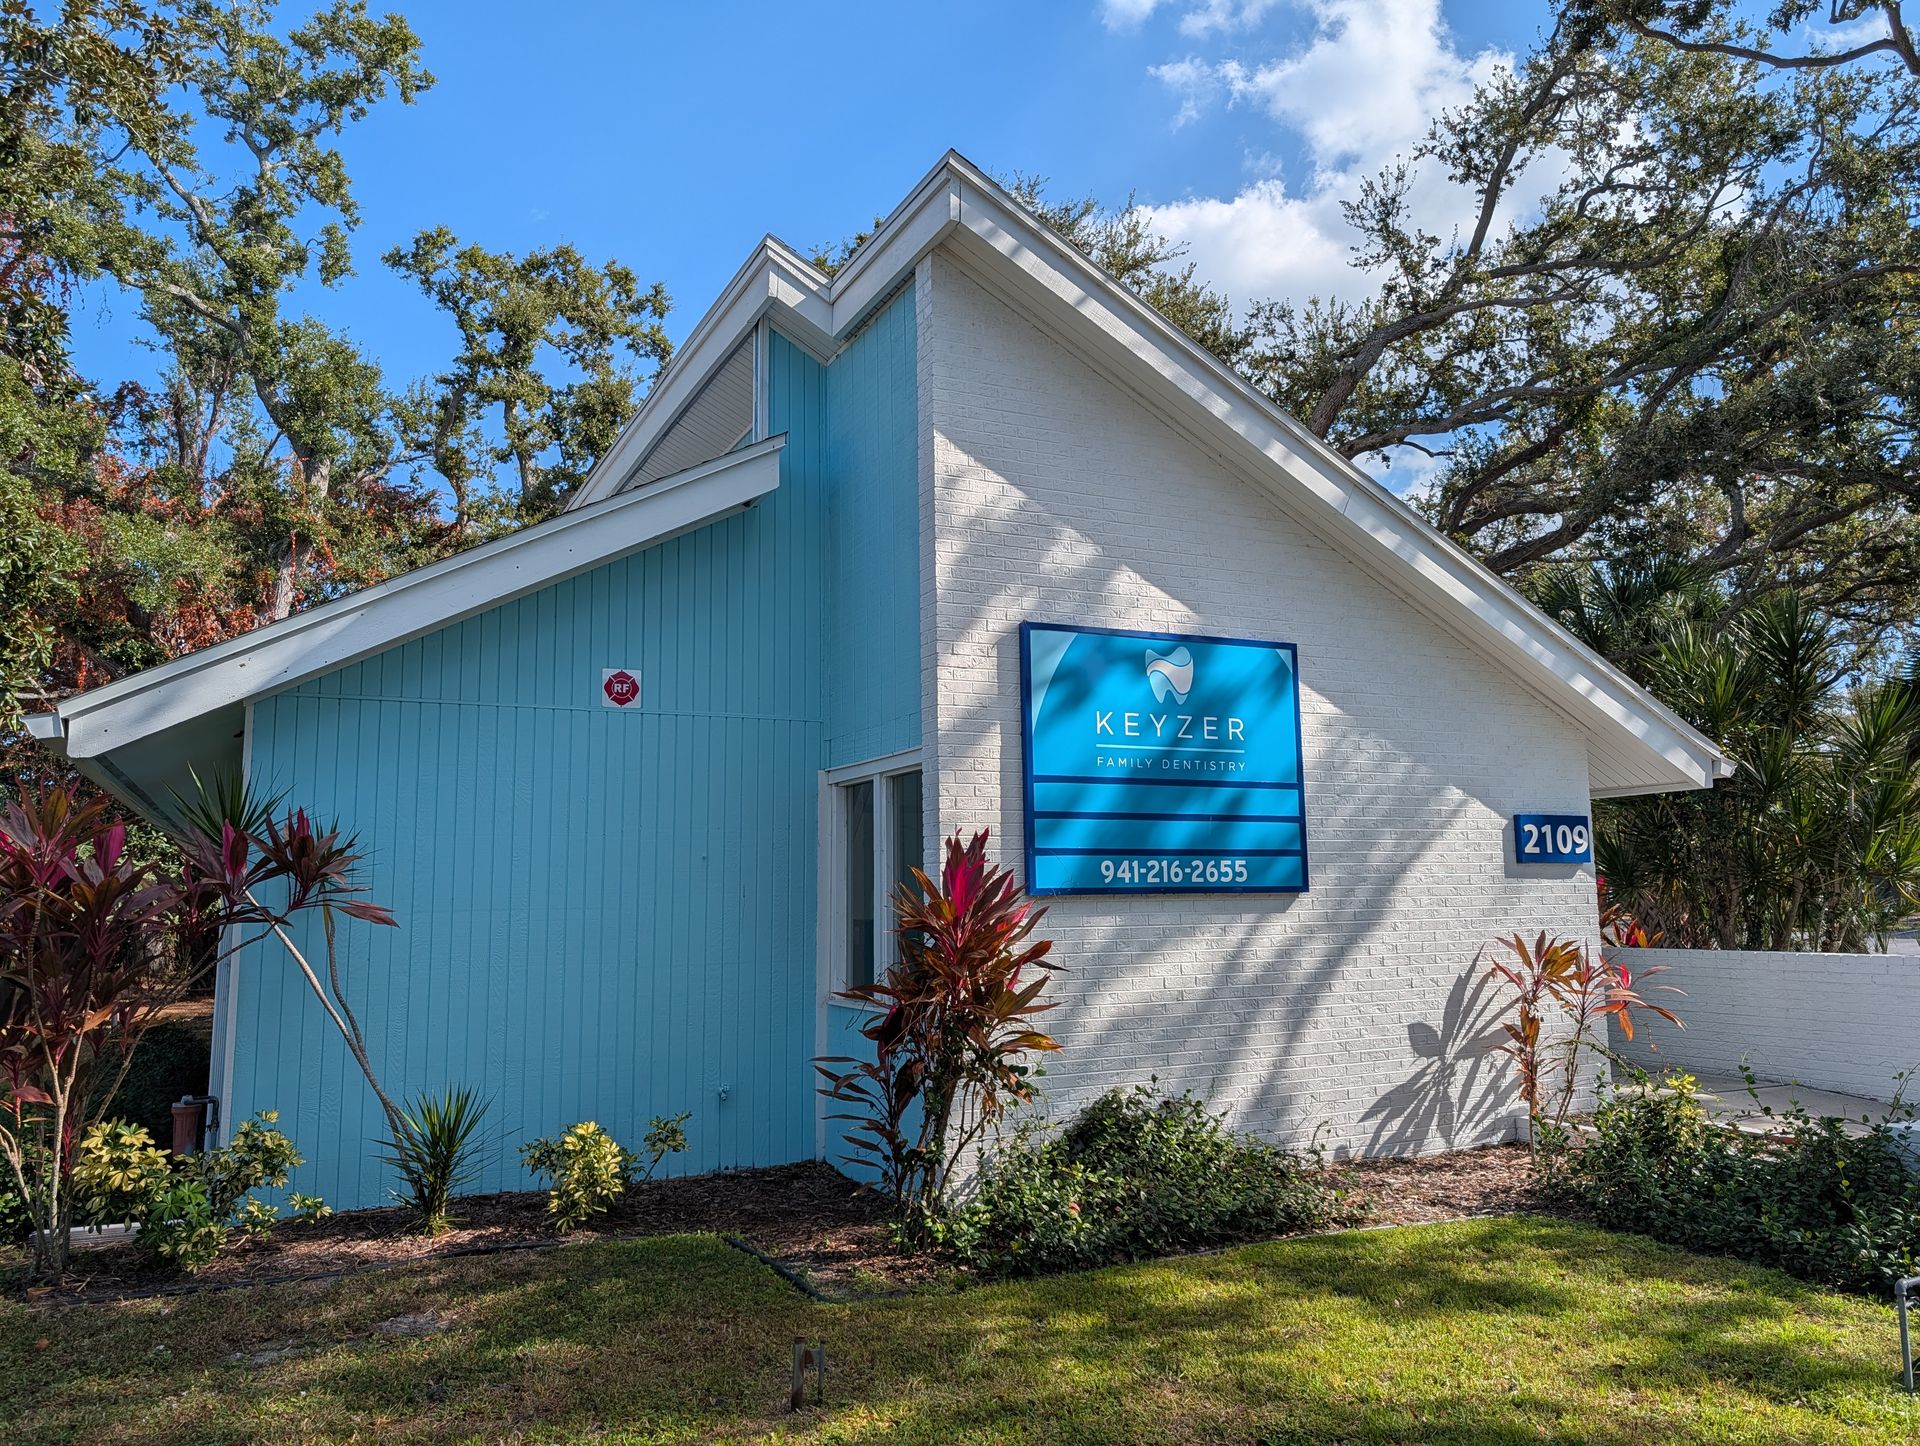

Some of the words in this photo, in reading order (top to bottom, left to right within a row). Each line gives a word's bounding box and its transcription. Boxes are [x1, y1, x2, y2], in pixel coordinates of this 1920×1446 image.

[613, 683, 630, 693] RF
[1096, 711, 1245, 741] KEYZER
[1097, 757, 1152, 769] FAMILY
[1162, 759, 1246, 771] DENTISTRY
[1523, 824, 1589, 854] 2109
[1101, 860, 1248, 883] 941-216-2655
